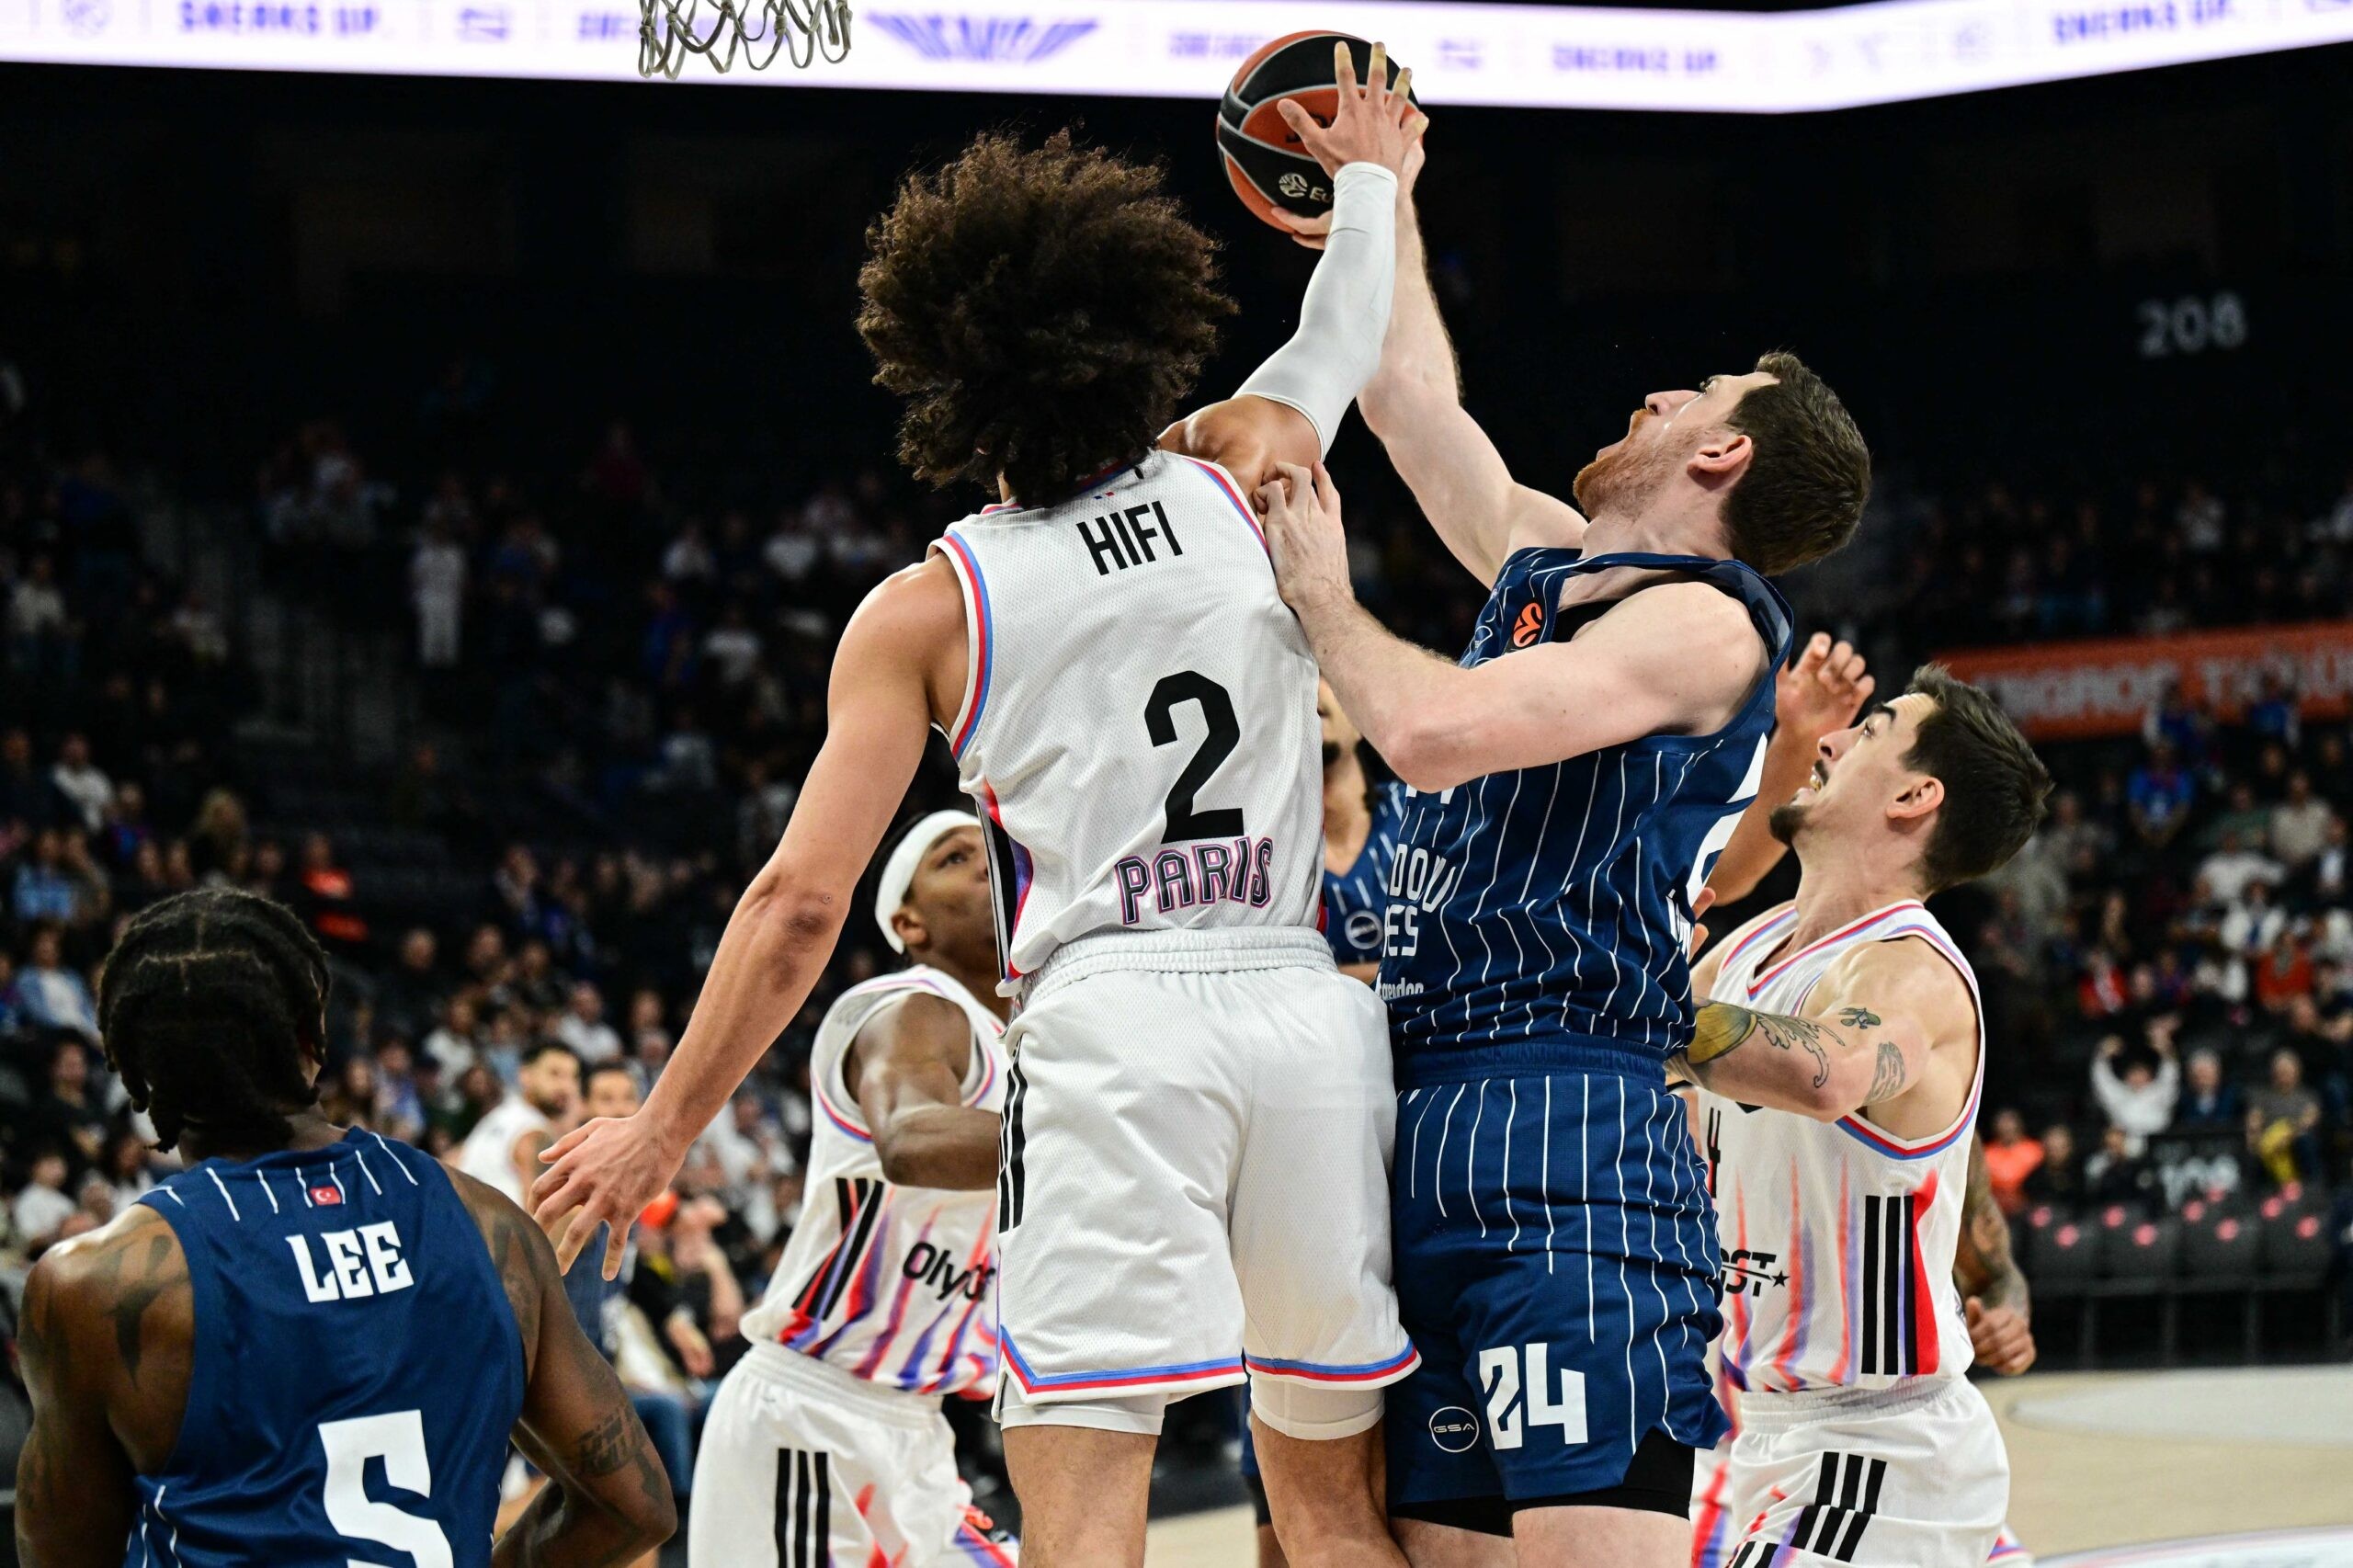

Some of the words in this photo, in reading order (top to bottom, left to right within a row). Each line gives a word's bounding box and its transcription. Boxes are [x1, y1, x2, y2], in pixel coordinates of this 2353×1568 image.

[2136, 294, 2247, 357] 208
[1076, 500, 1184, 576] HIFI
[1144, 670, 1245, 845] 2
[1115, 835, 1274, 926] PARIS
[285, 1221, 414, 1303] LEE
[1433, 1423, 1475, 1434] GSA
[1479, 1342, 1588, 1450] 24
[318, 1409, 454, 1568] 5
